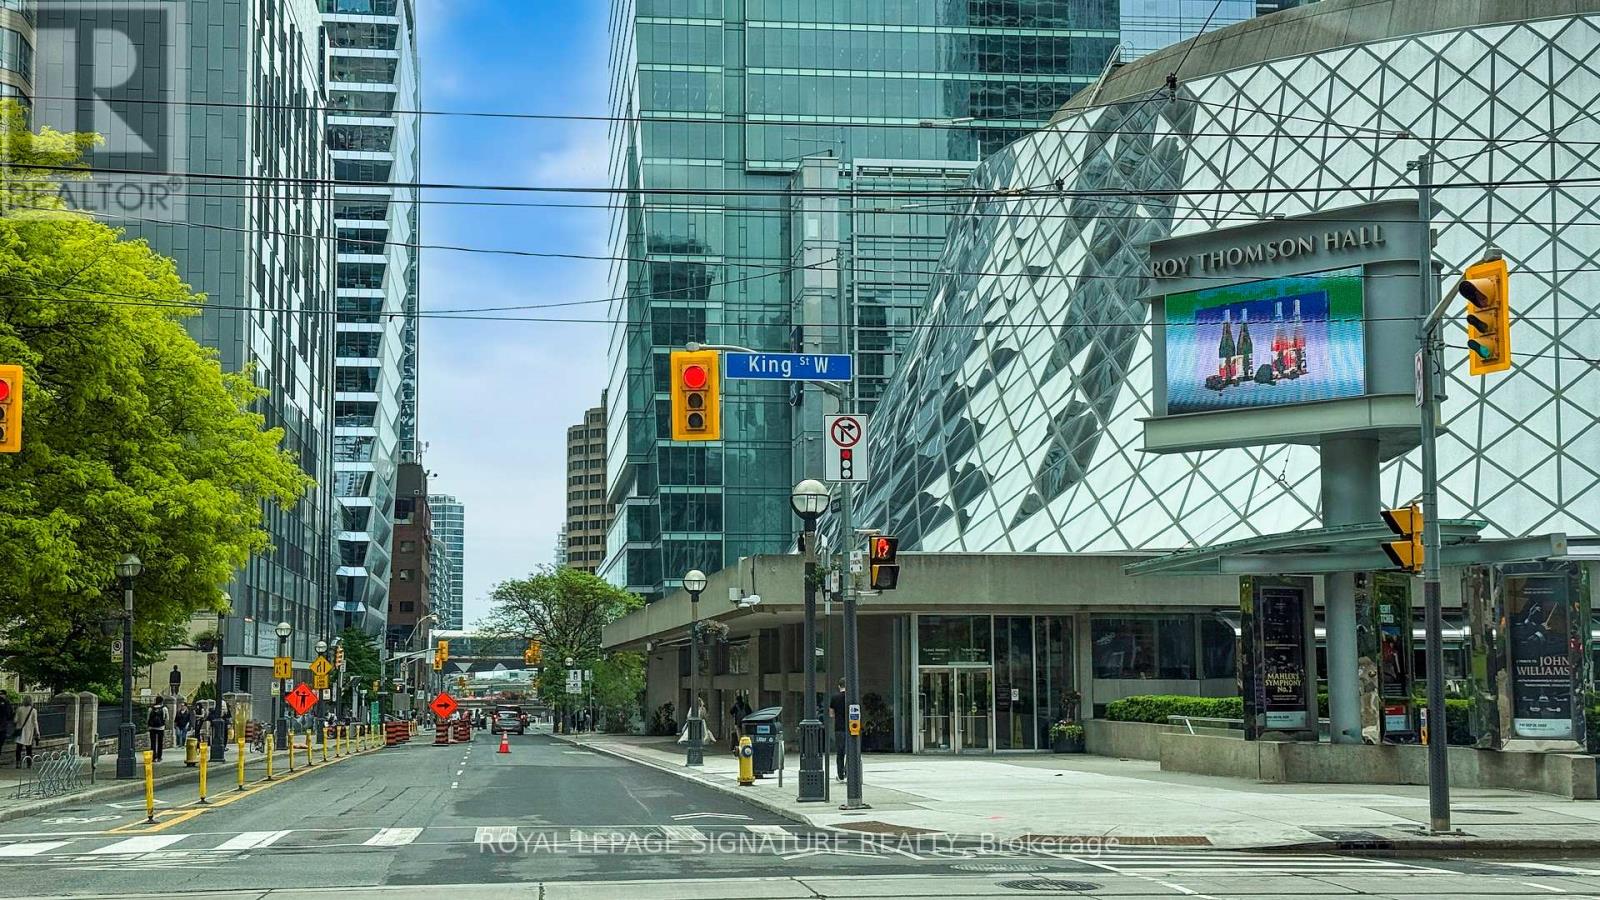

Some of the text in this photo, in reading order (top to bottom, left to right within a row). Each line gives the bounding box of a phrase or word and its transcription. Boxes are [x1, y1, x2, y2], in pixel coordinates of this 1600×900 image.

[1151, 224, 1385, 277] ROY THOMSON HALL
[749, 355, 829, 377] King St W
[1540, 656, 1570, 667] JOHN
[1517, 666, 1570, 676] WILLIAMS
[1265, 679, 1302, 687] SYMPHONY
